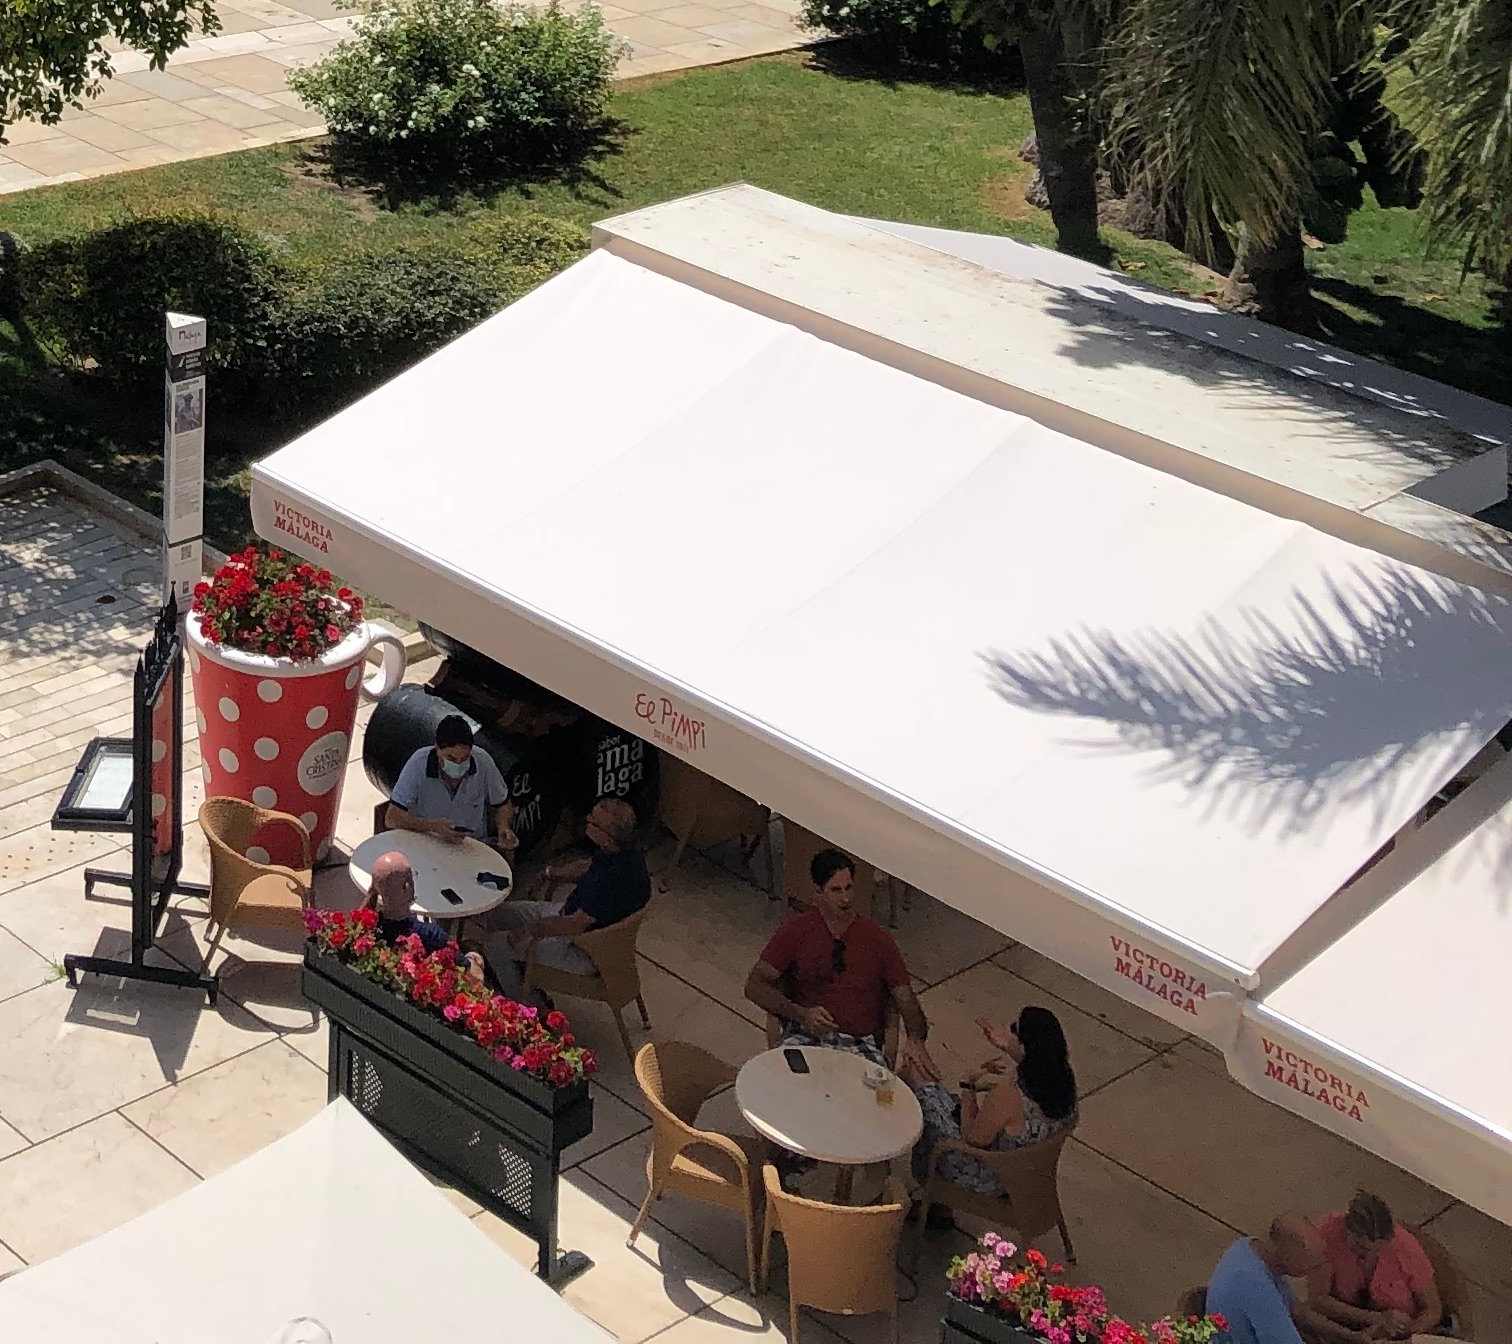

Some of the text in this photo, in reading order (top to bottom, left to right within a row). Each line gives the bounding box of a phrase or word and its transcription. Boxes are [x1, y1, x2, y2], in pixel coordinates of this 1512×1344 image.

[273, 499, 334, 542] VICTORIA
[274, 516, 328, 553] MÁLAGA
[596, 762, 645, 797] laga
[1109, 935, 1207, 1000] VICTORIA
[1114, 956, 1198, 1016] MÁLAGA
[1261, 1038, 1370, 1108] VICTORIA
[1264, 1060, 1364, 1122] MÁLAGA
